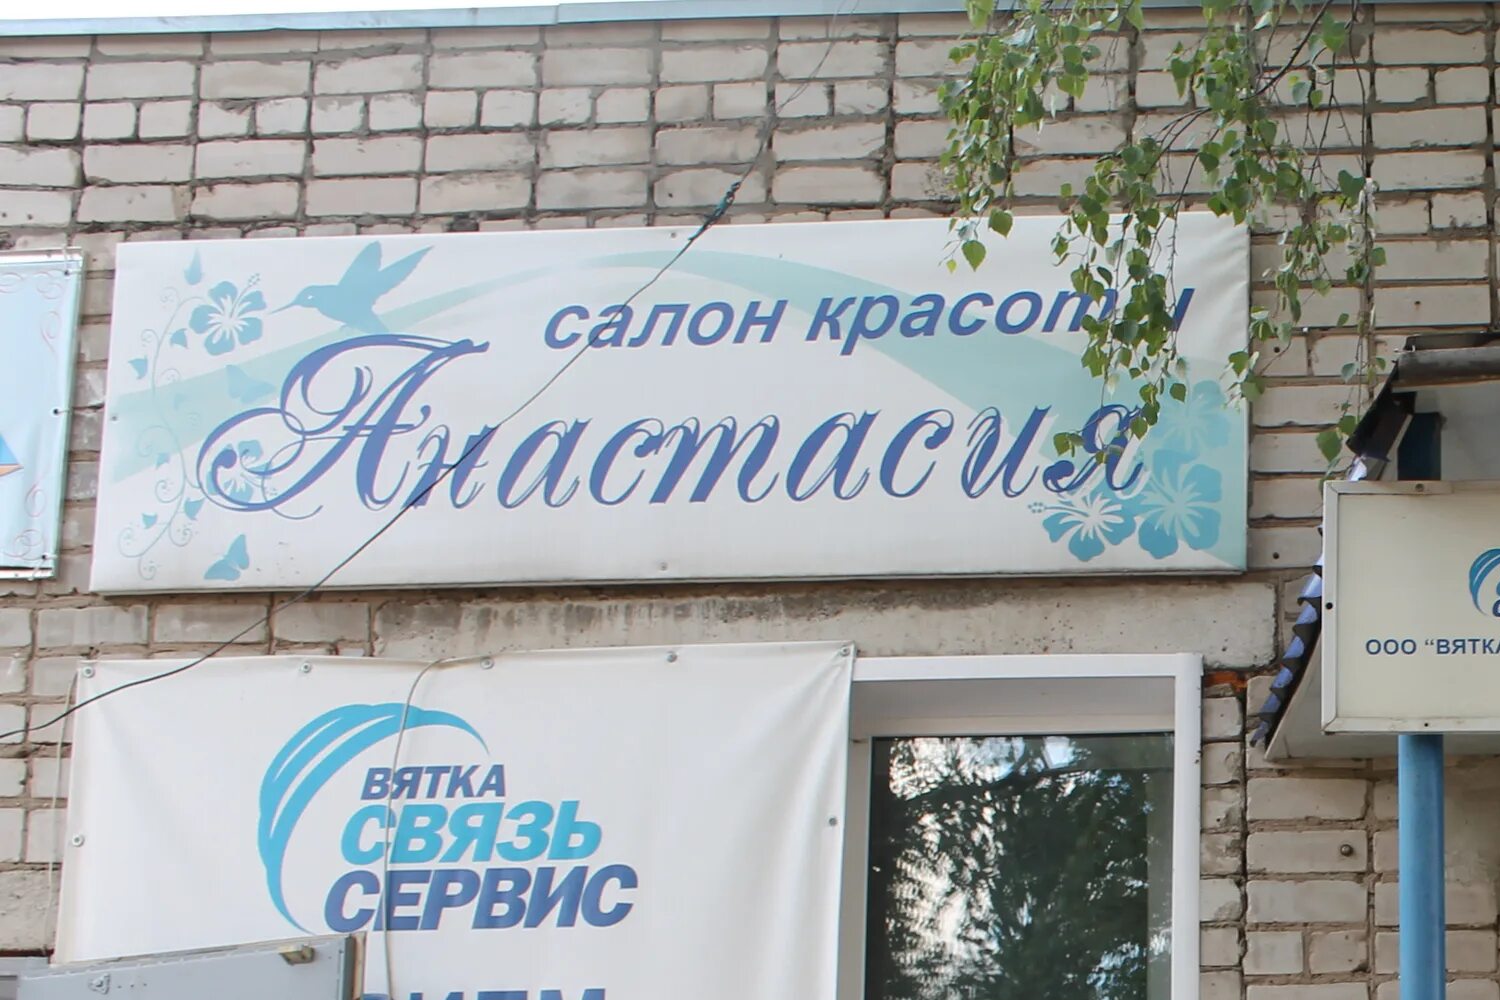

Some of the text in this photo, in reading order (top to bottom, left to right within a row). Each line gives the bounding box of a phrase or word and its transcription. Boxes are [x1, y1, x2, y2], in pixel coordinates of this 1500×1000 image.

[544, 298, 788, 350] салон
[196, 333, 1146, 519] Анастасия
[1365, 638, 1417, 655] ООО
[360, 763, 506, 801] ВЯТКА
[341, 800, 603, 866] СВЯЗЬ
[324, 864, 639, 932] СЕРВИС
